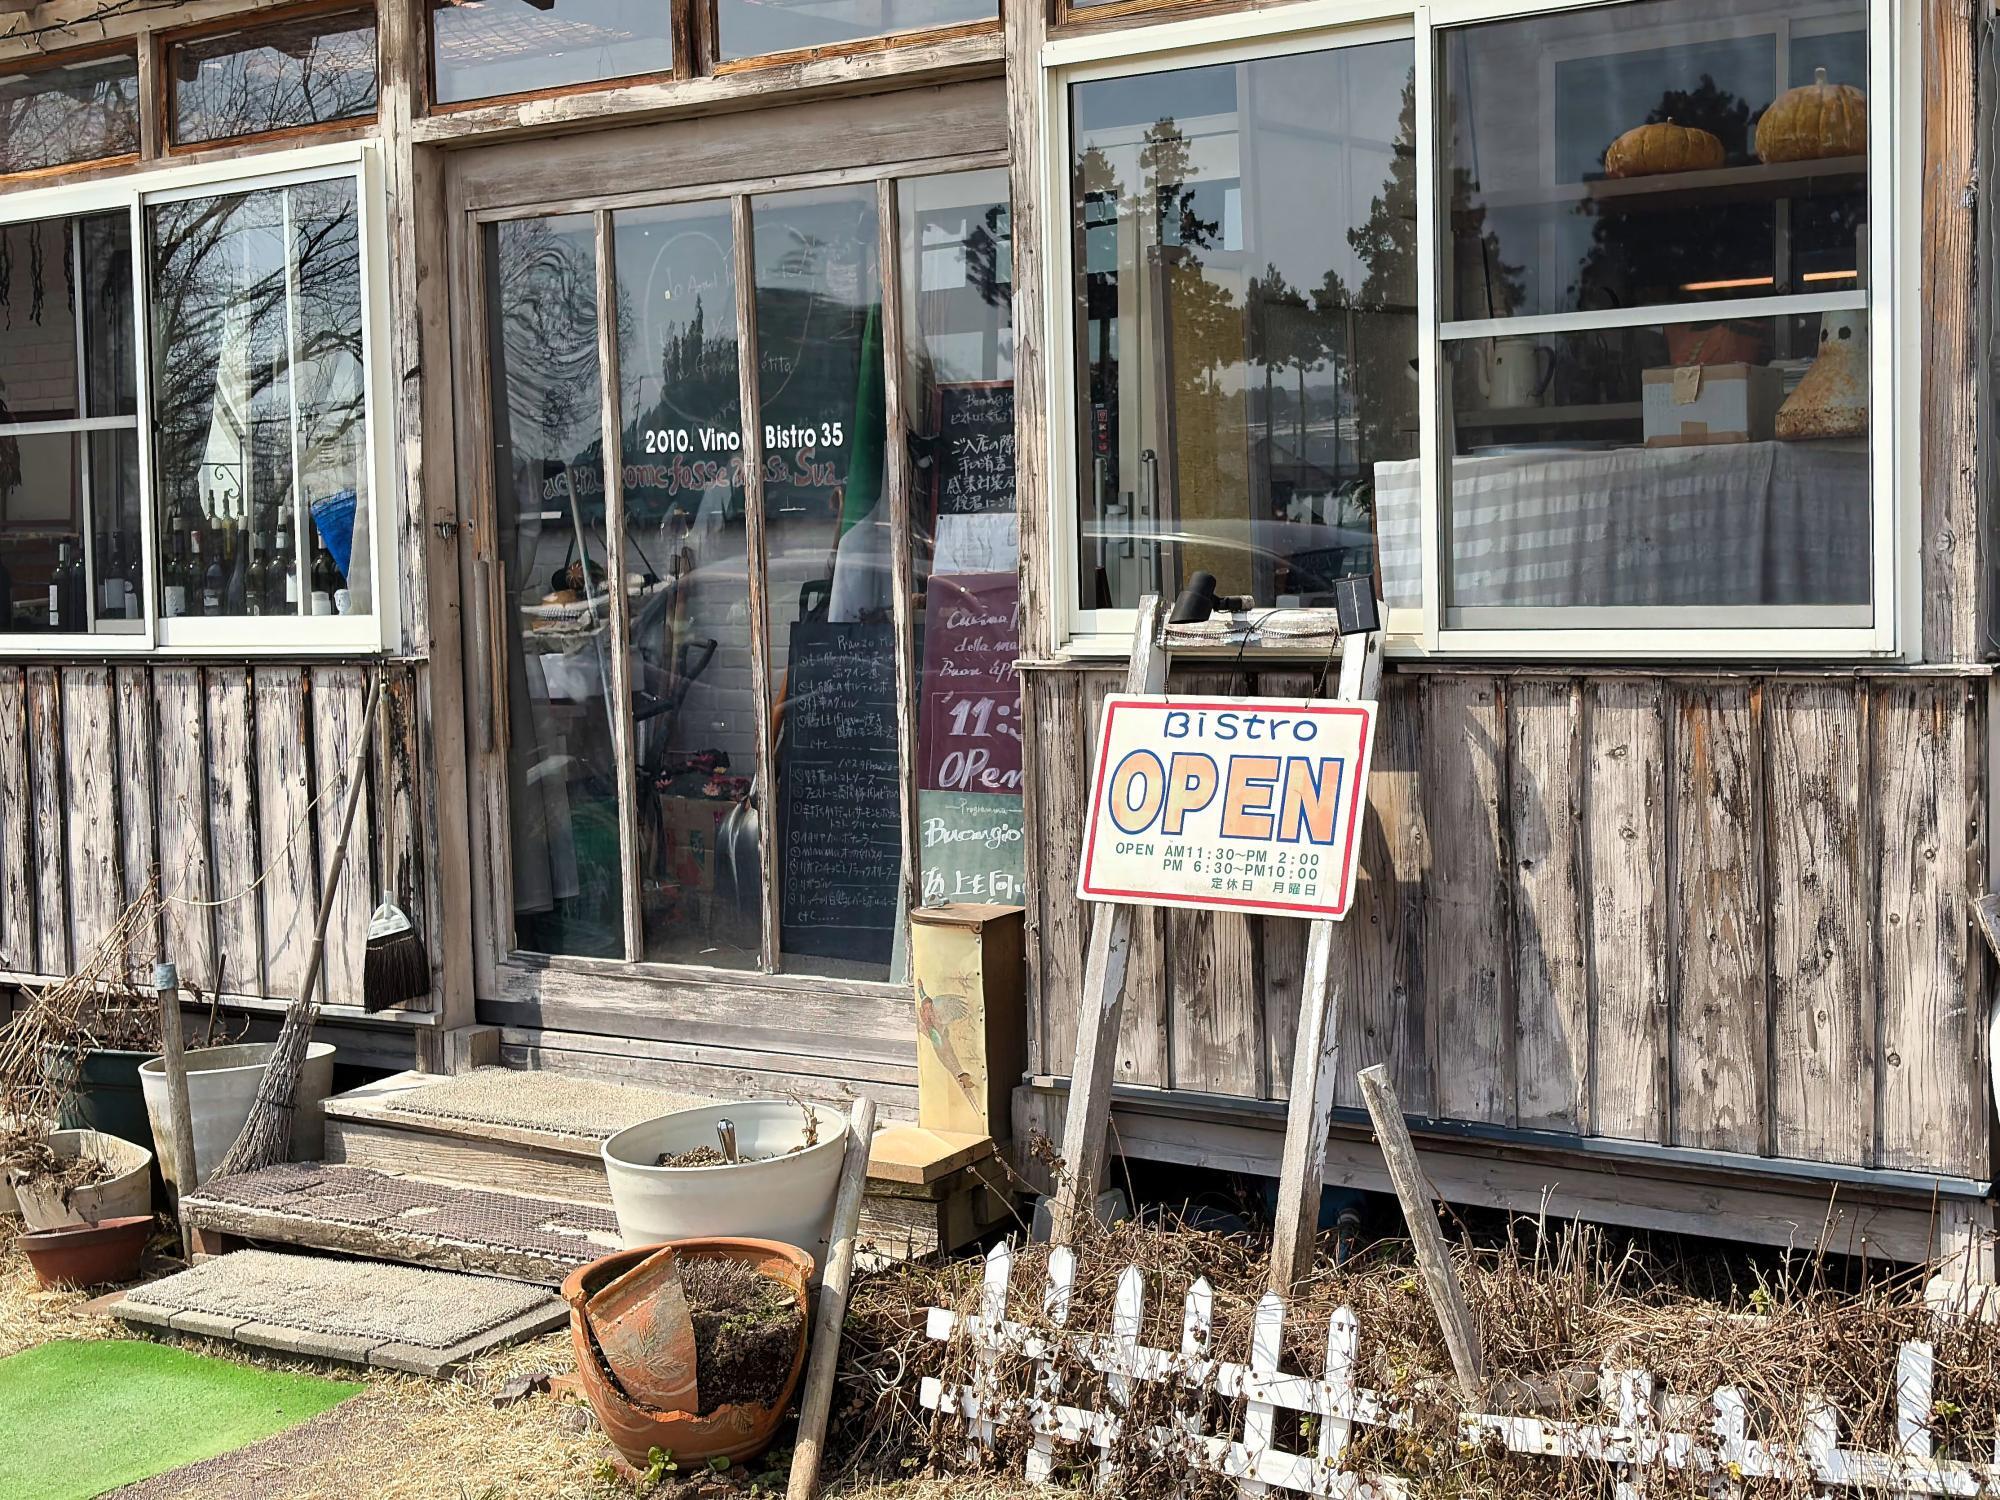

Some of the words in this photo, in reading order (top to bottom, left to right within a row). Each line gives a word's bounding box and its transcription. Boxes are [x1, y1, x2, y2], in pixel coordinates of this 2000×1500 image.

[645, 430, 694, 453] 2010.
[699, 428, 740, 451] Vino
[765, 424, 816, 449] Bistro
[820, 422, 844, 447] 35
[1108, 748, 1345, 846] OPEN
[1115, 842, 1154, 856] OPEN
[1278, 851, 1320, 866] 2:00
[1163, 858, 1183, 872] PM
[1211, 877, 1254, 892] 定休日
[1272, 881, 1317, 897] 月曜日
